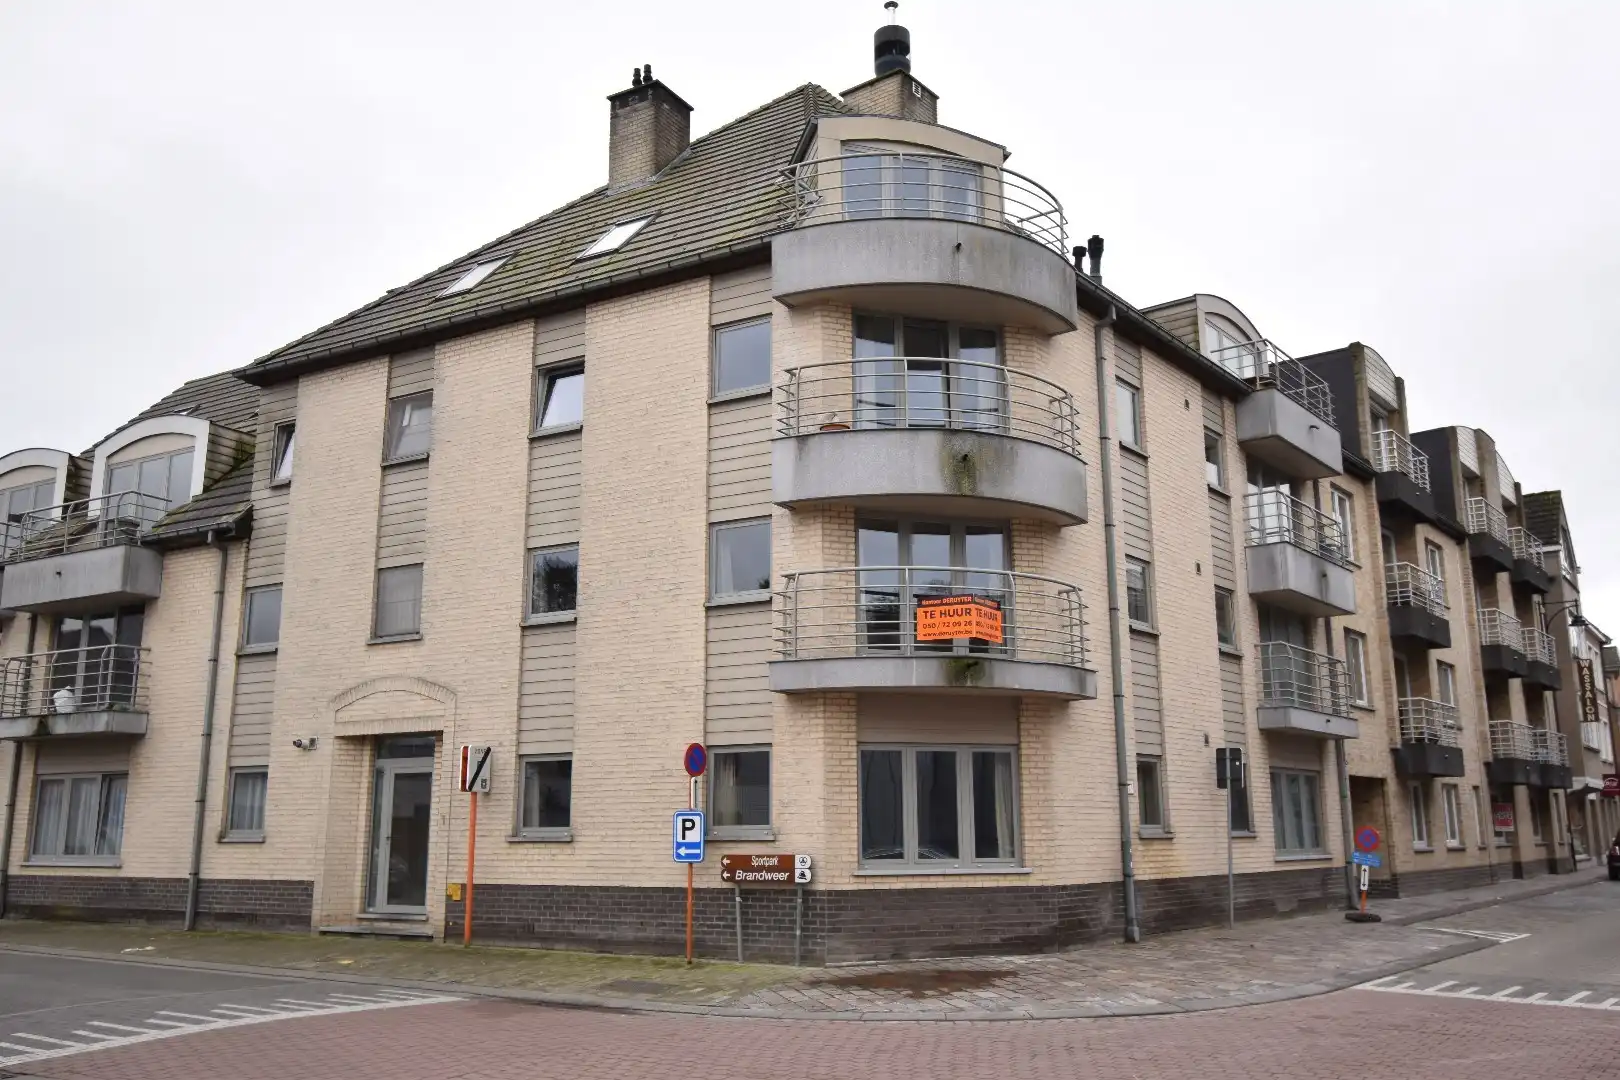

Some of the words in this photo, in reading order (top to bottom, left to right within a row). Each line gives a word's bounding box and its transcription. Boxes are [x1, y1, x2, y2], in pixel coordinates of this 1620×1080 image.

[922, 610, 936, 619] TE
[939, 608, 972, 618] HUUR
[1580, 660, 1595, 721] WASSALON
[681, 818, 696, 841] P
[751, 855, 778, 867] Sportpark
[735, 869, 789, 881] Brandweer
